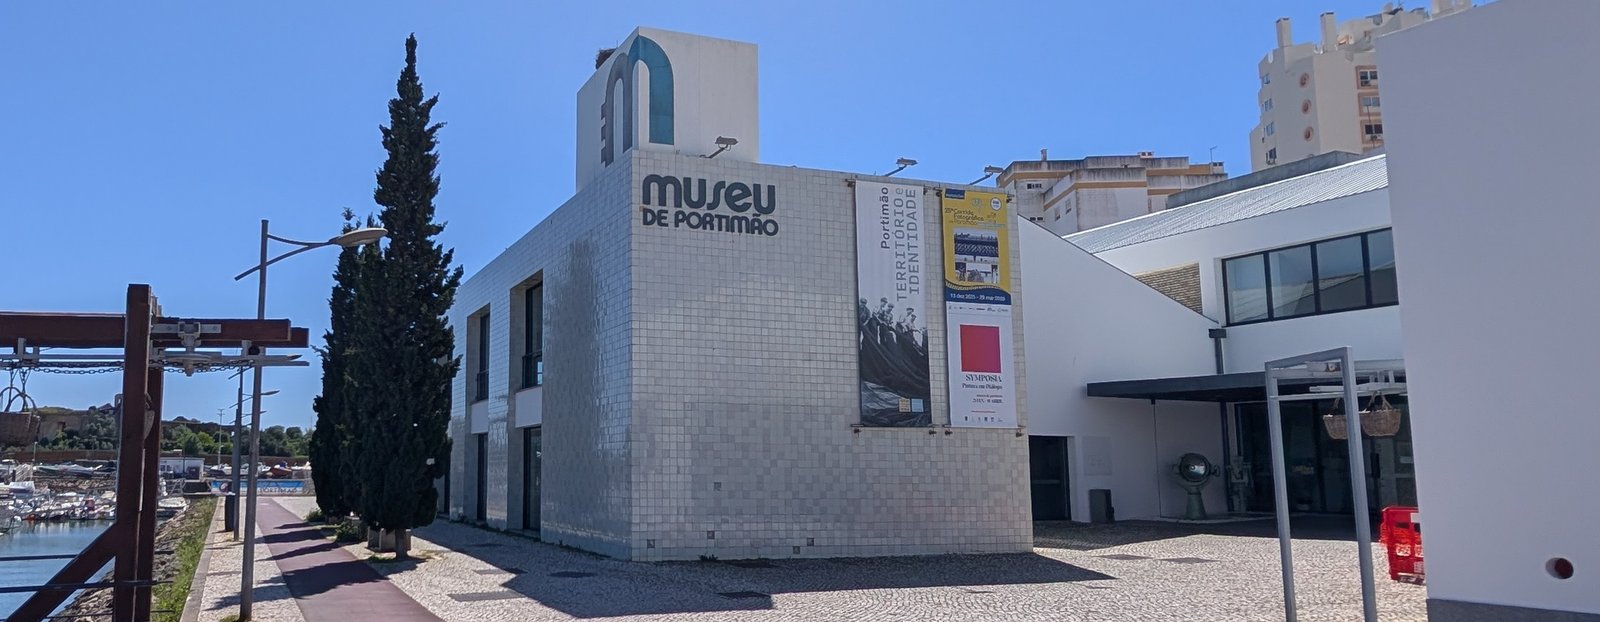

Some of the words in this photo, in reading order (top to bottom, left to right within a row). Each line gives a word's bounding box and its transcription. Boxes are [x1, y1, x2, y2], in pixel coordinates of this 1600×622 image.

[895, 187, 904, 195] e
[642, 208, 669, 227] DE
[674, 210, 779, 236] PORTIMÃO
[880, 187, 890, 249] Portimão
[892, 198, 908, 302] TERRITÓRIO
[906, 189, 920, 295] IDENTIDADE
[965, 374, 1002, 382] SYMPOSIA
